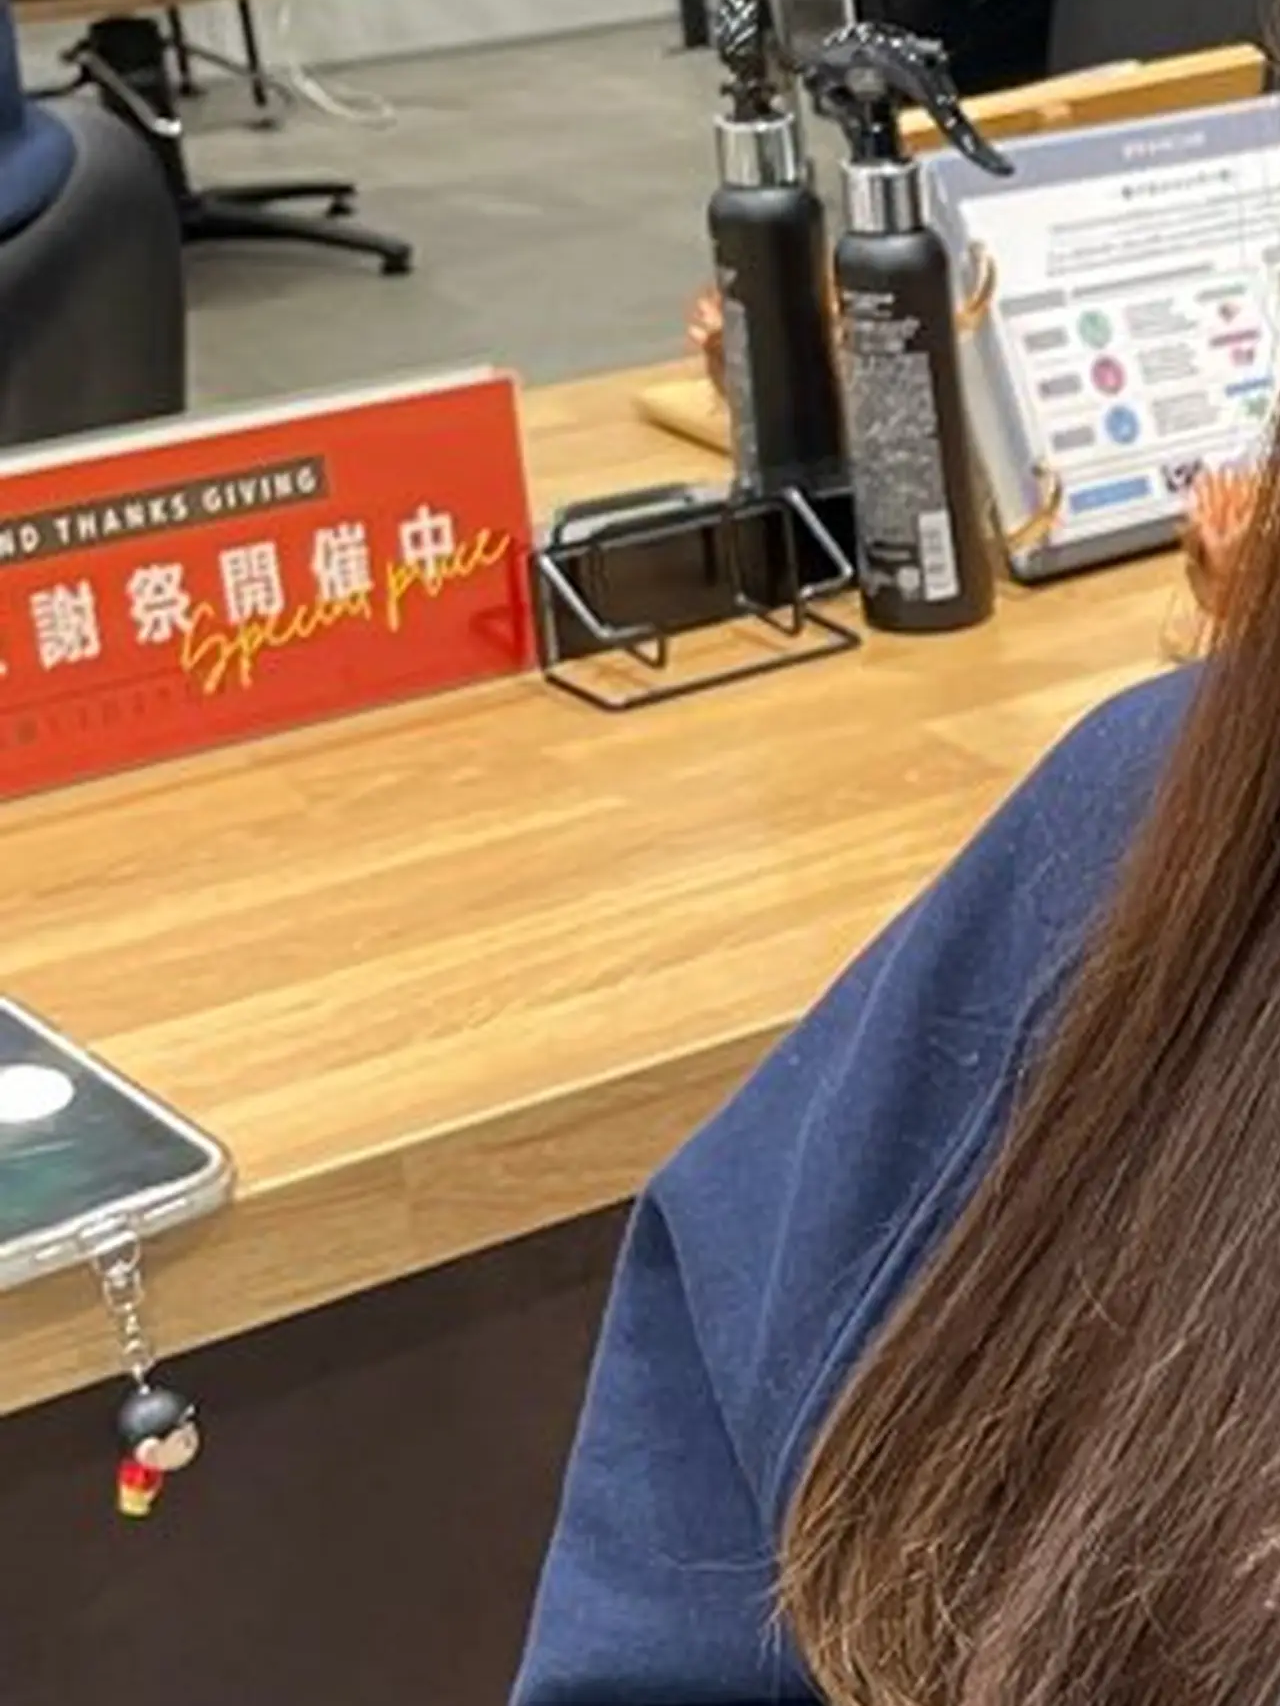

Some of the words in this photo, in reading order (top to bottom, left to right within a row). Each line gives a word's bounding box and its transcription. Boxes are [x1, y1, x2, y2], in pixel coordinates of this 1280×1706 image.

[53, 493, 188, 545] THANKS
[202, 466, 318, 513] GIVING
[0, 504, 455, 676] 謝祭開催中
